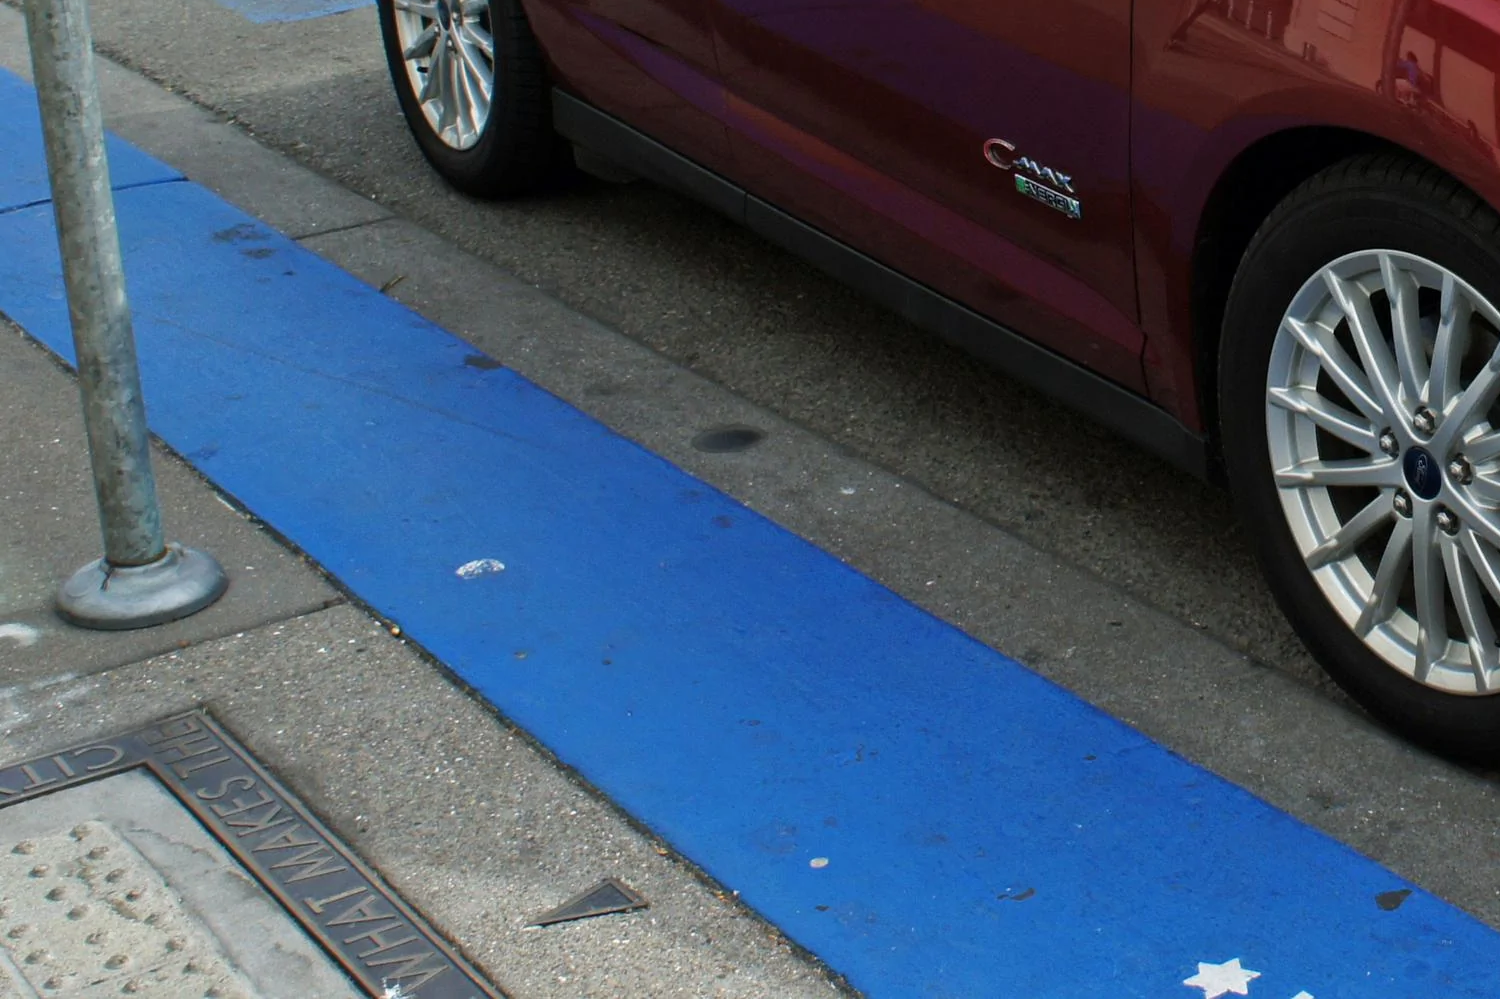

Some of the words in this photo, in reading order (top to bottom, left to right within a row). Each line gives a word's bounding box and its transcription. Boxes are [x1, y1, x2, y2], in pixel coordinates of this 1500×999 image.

[148, 716, 232, 780] THE
[196, 777, 348, 885] MAKES
[304, 885, 450, 996] WHAT
